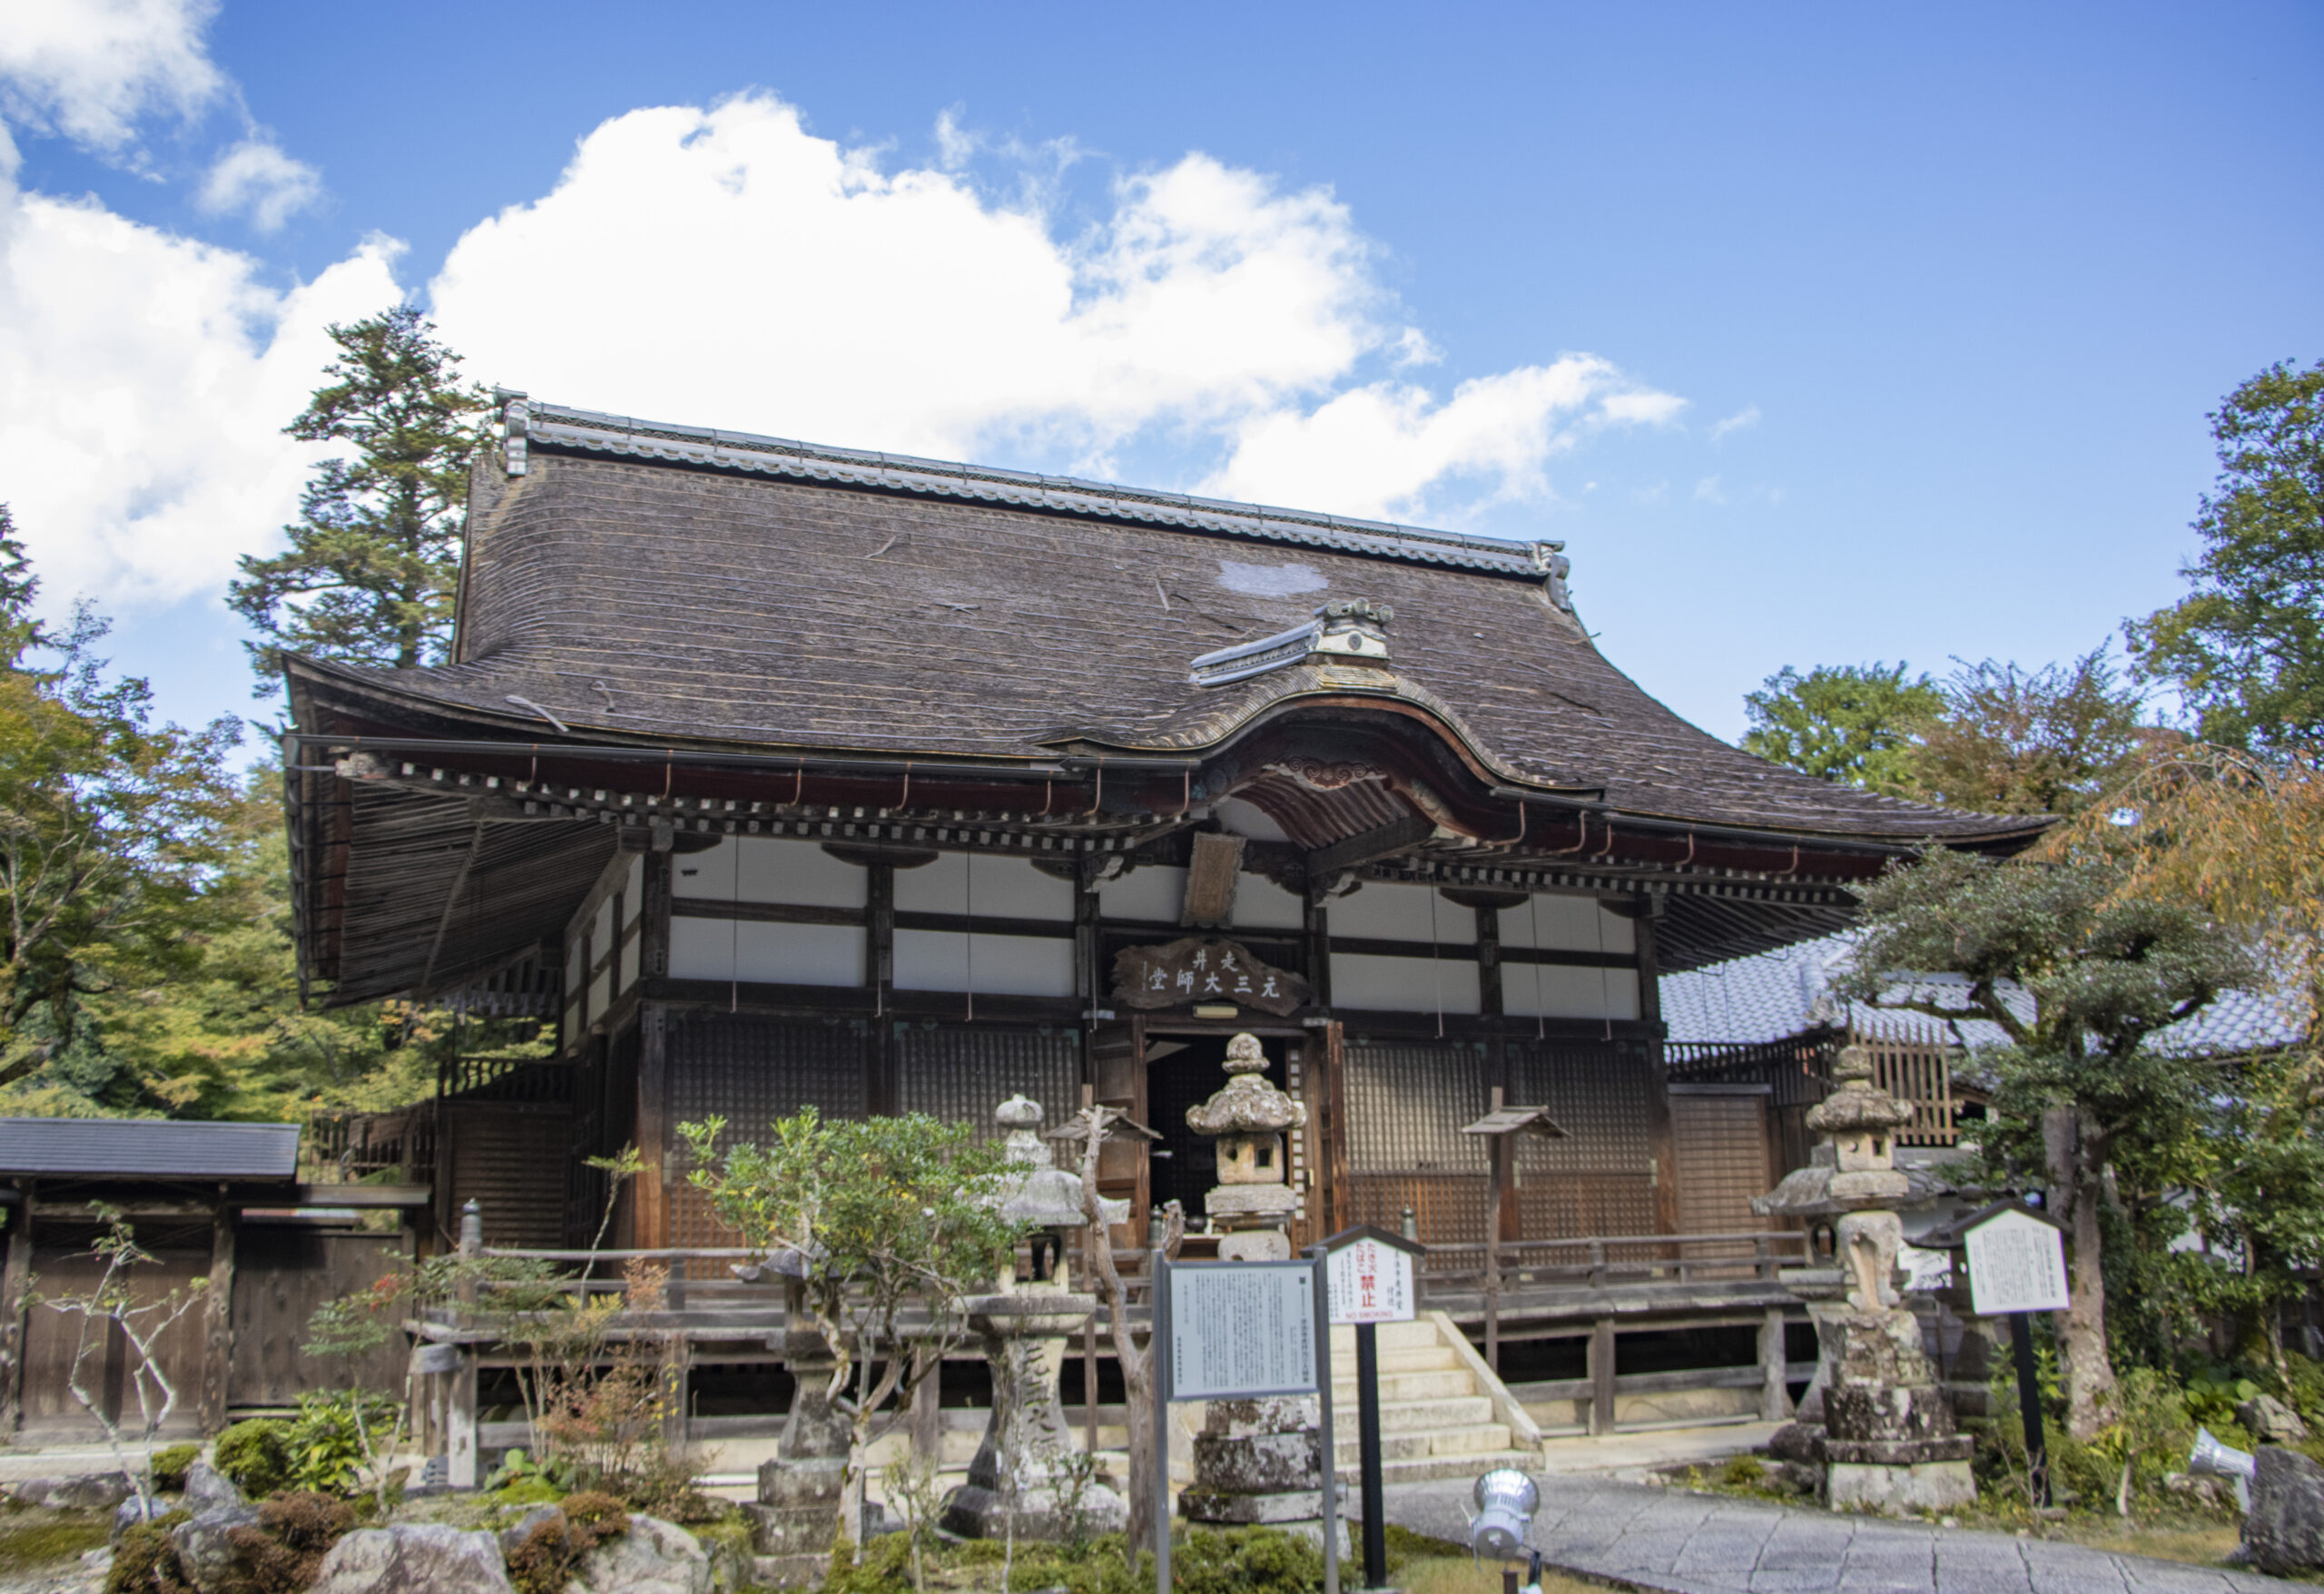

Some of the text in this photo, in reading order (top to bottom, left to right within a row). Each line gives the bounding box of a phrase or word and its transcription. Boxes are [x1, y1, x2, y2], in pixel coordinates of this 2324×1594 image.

[1193, 948, 1238, 972] 走井
[1148, 967, 1280, 998] 元三大師堂
[1355, 1243, 1366, 1274] たばこ
[1367, 1243, 1378, 1274] たき火
[1361, 1274, 1376, 1308] 禁止
[1345, 1310, 1393, 1320] NO SMOKING
